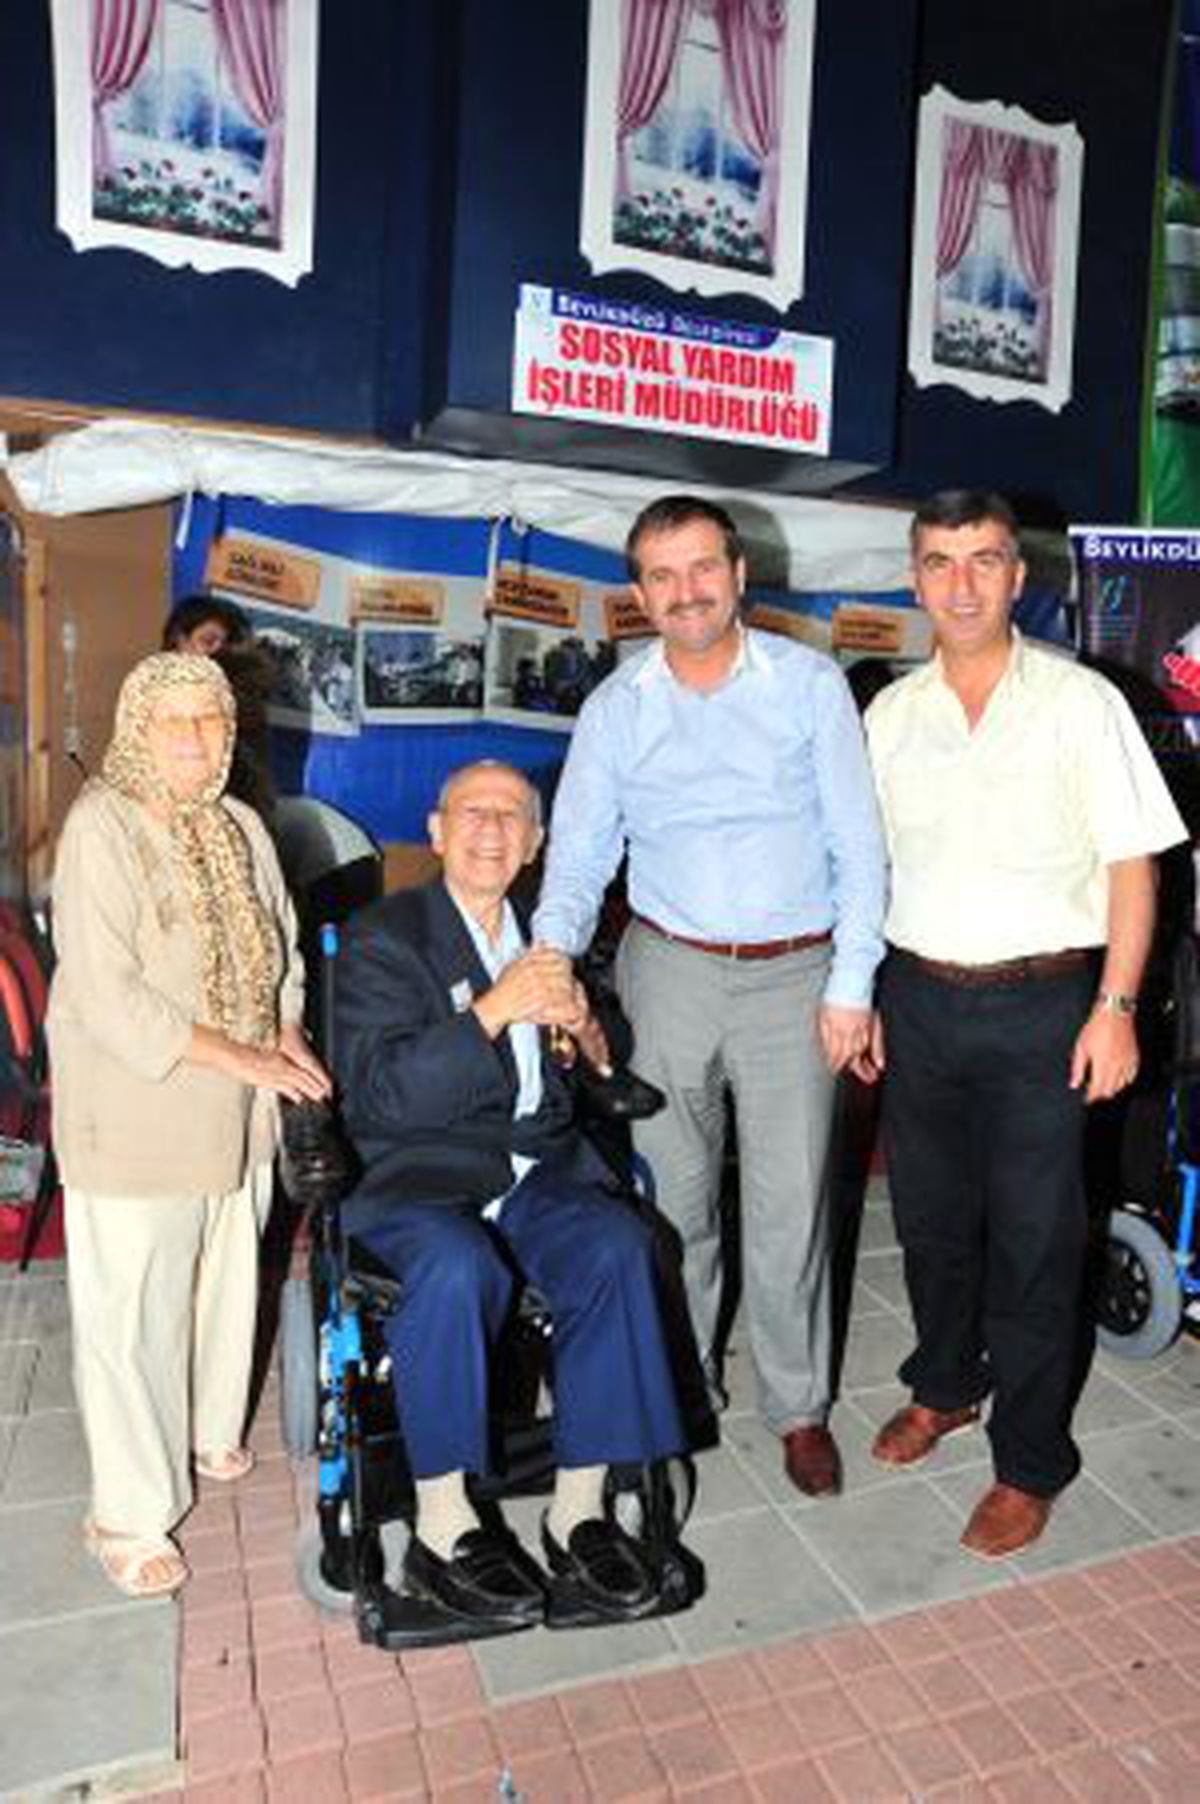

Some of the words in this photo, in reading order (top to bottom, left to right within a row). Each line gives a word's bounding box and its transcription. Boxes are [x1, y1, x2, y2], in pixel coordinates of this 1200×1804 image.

[559, 322, 674, 377] SOSYAL
[682, 343, 796, 394] YARDIM
[527, 357, 627, 414] İŞLERİ
[634, 377, 820, 442] MÜDÜRLÜĞÜ
